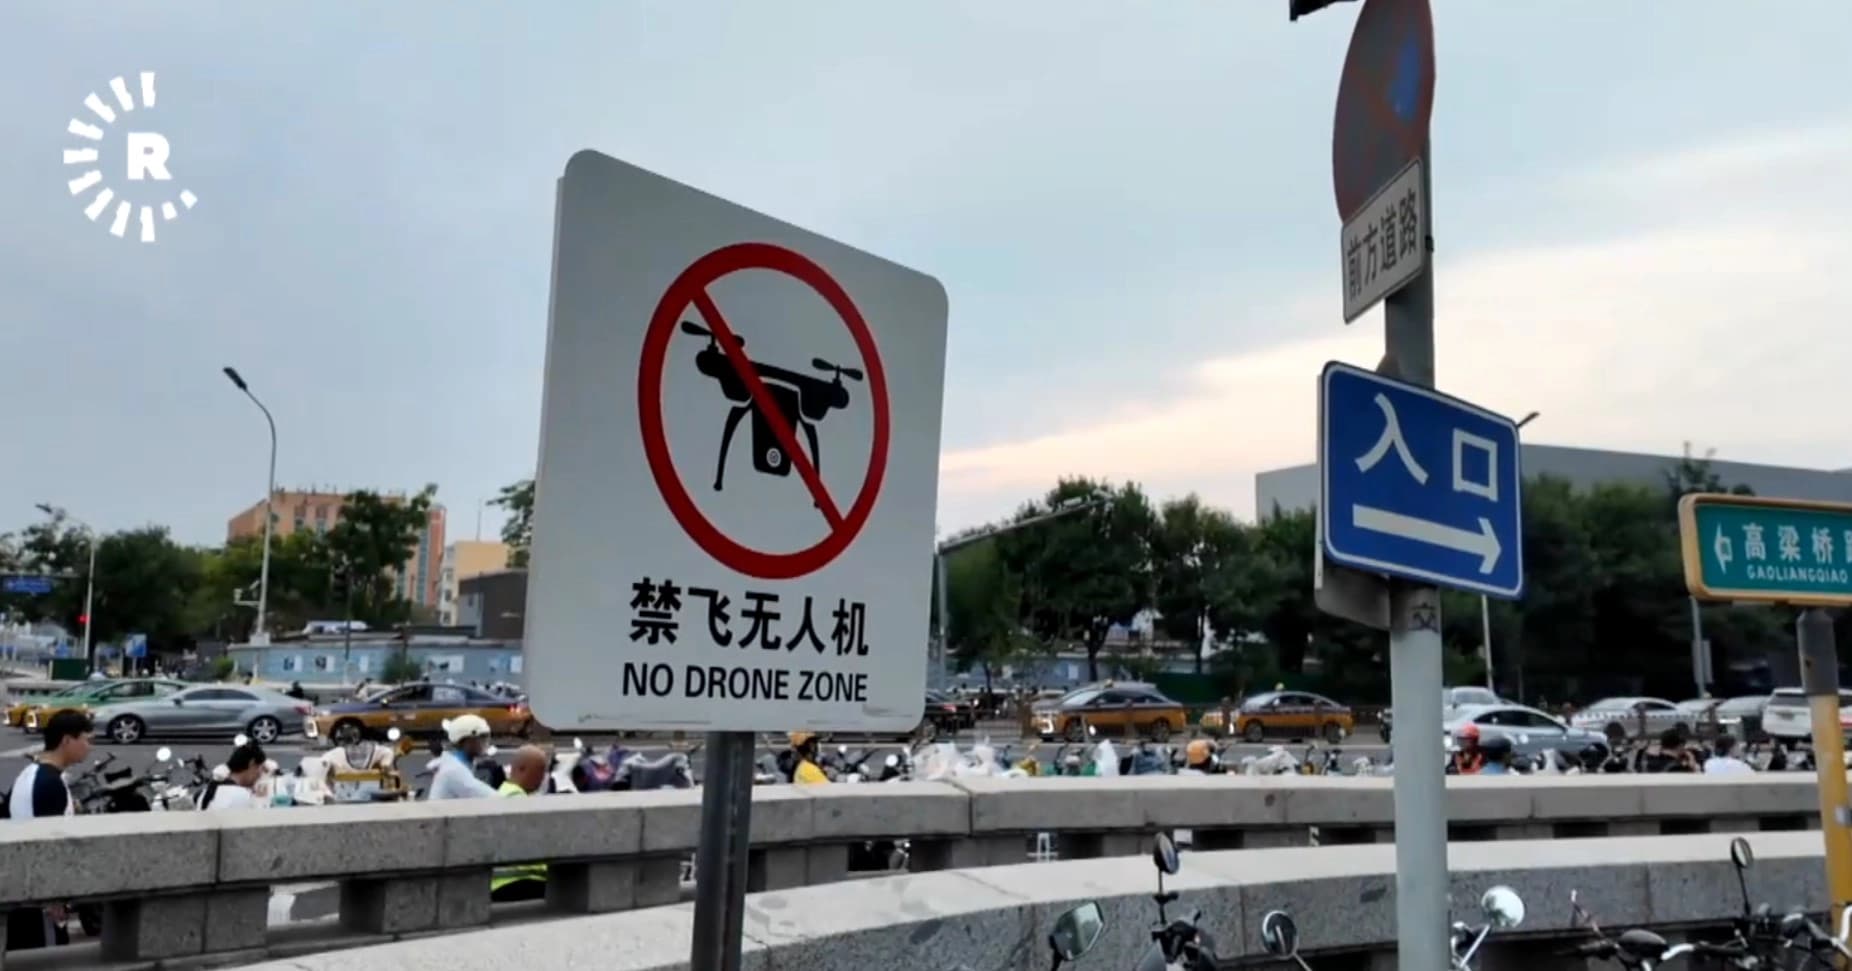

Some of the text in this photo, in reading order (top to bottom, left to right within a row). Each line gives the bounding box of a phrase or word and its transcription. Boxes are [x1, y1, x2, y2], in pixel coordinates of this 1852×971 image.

[1347, 187, 1417, 298] 前方道路
[1354, 392, 1498, 502] 入口
[1746, 563, 1849, 584] GAOLIANGQIAO
[629, 576, 869, 656] 禁飞无人机
[622, 662, 869, 702] NO DRONE ZONE
